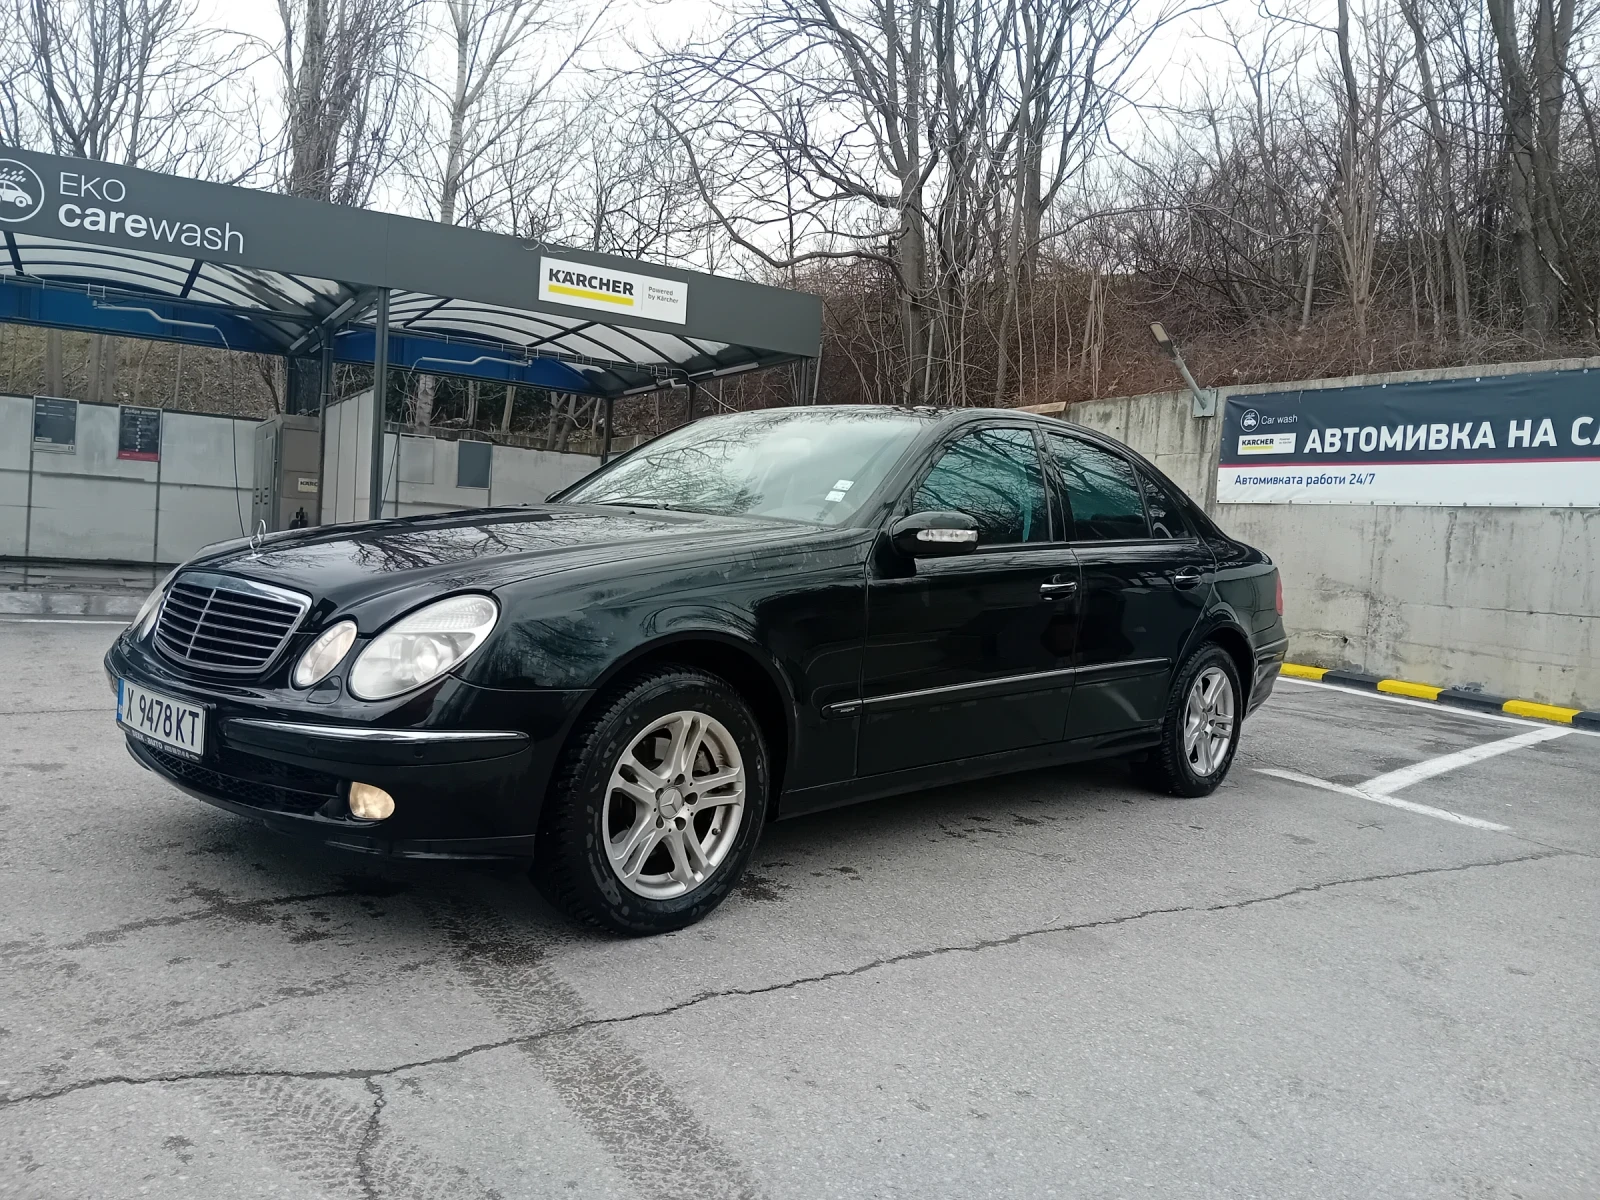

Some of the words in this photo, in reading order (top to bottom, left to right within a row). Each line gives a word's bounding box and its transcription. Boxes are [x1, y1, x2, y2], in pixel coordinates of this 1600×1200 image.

[59, 172, 126, 203] EKO
[58, 203, 244, 254] carewash
[548, 268, 634, 296] KÄRCHER
[648, 286, 673, 296] Powered
[647, 293, 655, 301] by
[1261, 415, 1275, 425] Car
[1277, 414, 1298, 424] wash
[1303, 421, 1497, 453] АВТОМИВКА
[1507, 418, 1558, 448] НА
[1234, 474, 1303, 486] Автомивката
[1305, 473, 1346, 487] работи
[1349, 473, 1376, 485] 24/7
